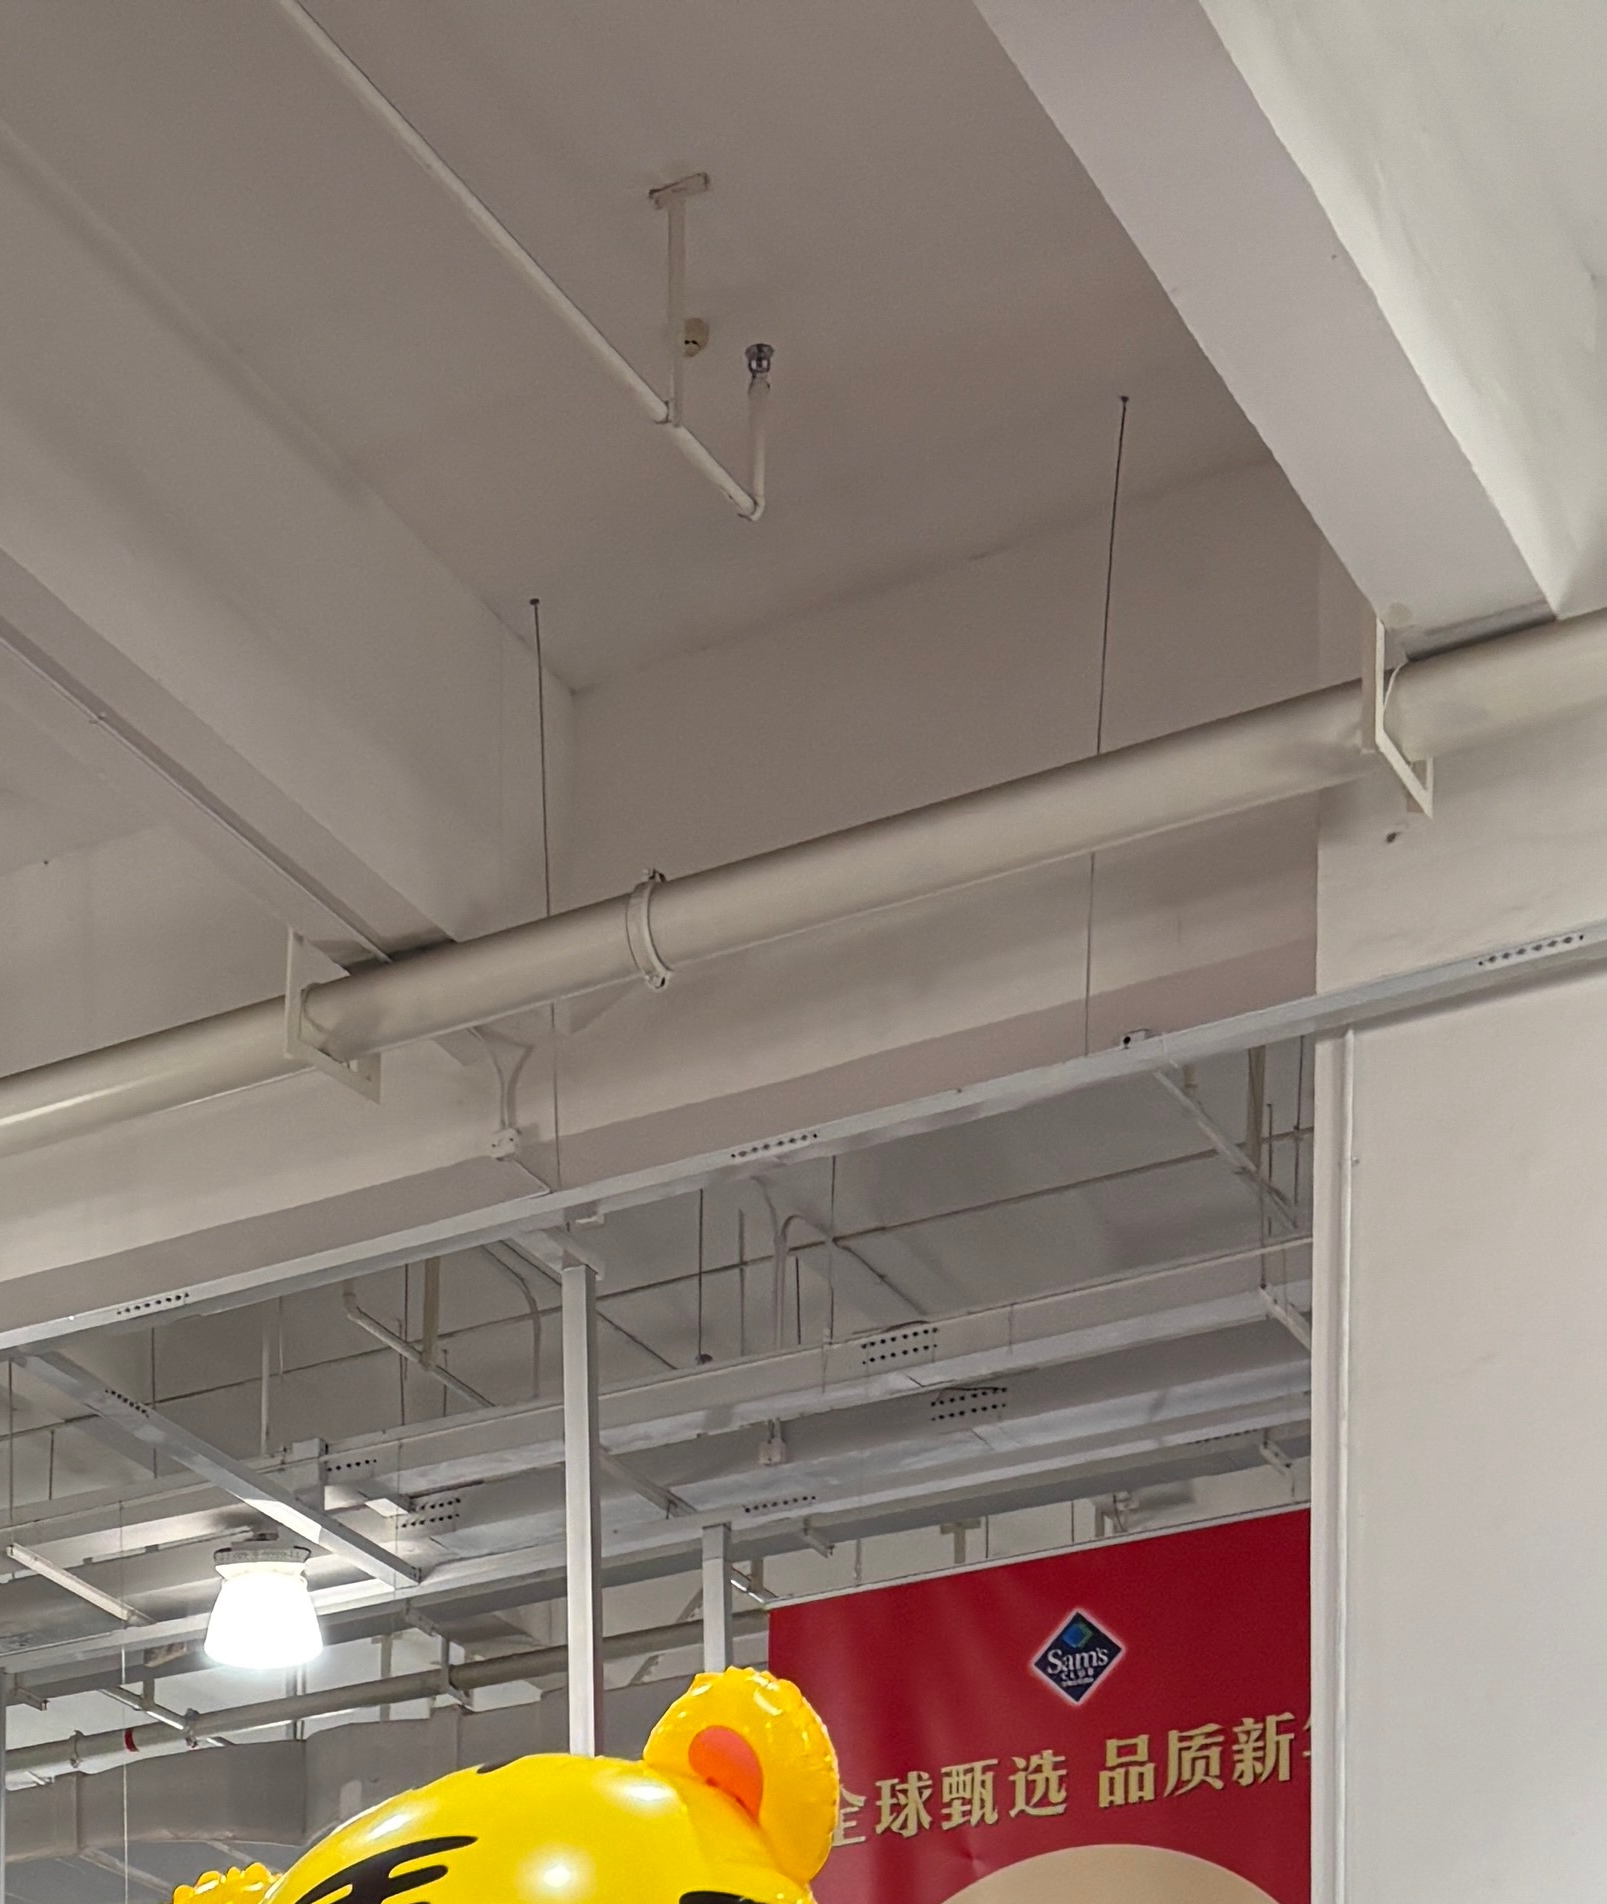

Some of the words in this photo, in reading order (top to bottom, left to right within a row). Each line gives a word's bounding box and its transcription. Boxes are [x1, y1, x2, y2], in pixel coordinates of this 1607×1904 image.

[1047, 1647, 1108, 1674] Sam's
[1098, 1712, 1312, 1808] 品质新
